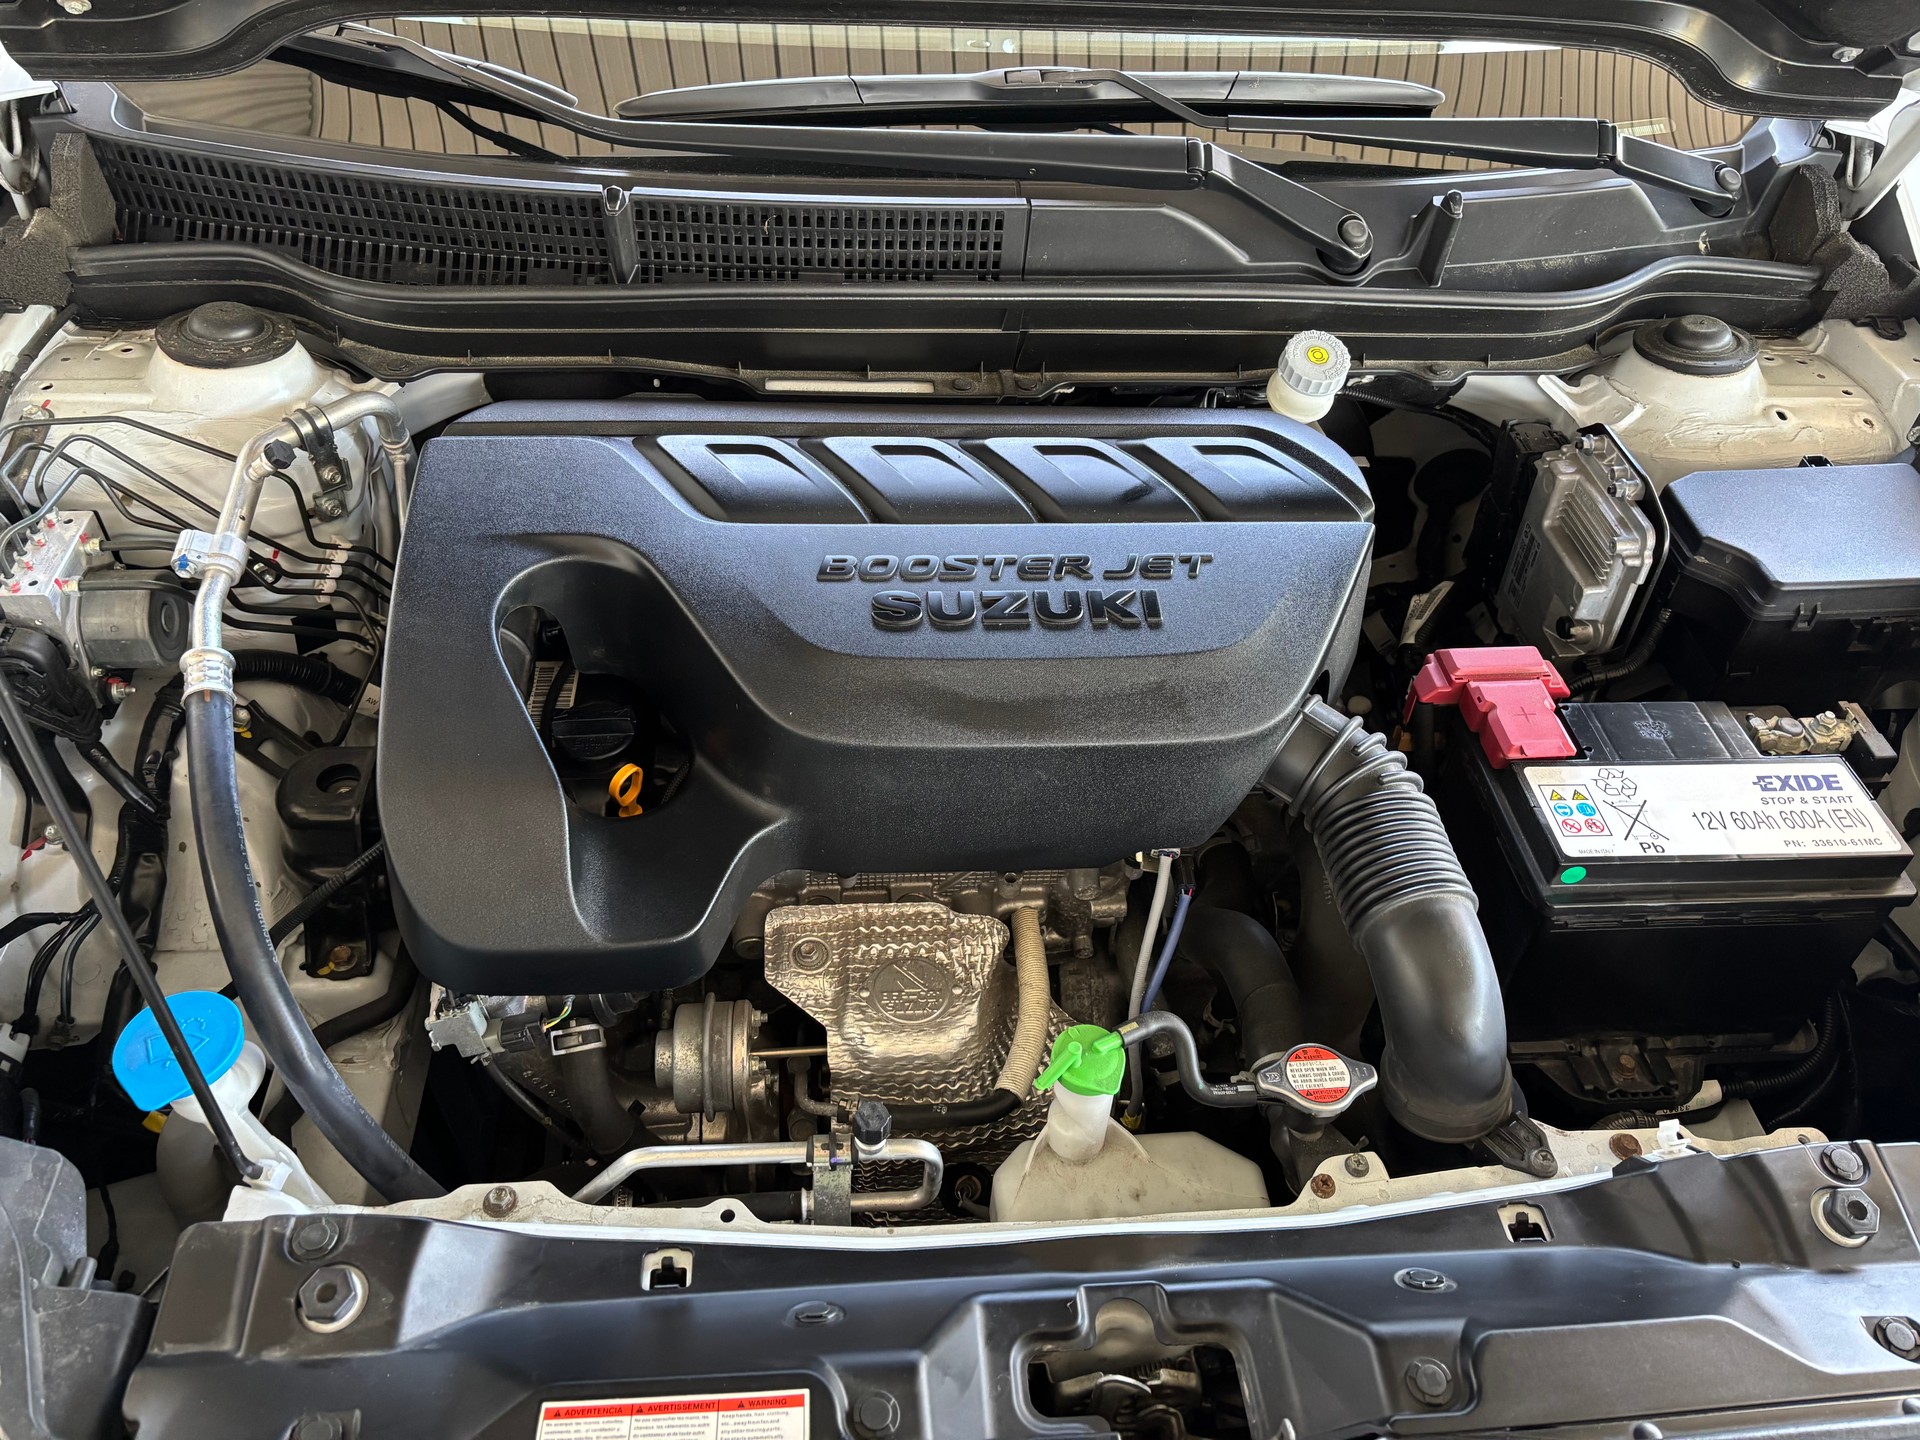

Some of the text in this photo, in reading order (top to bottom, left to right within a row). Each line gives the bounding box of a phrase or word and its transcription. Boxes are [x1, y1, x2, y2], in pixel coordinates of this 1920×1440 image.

[817, 552, 1214, 582] BOOSTER JET
[871, 588, 1164, 630] SUZUKI
[1752, 775, 1843, 792] EXIDE
[1760, 795, 1854, 805] STOP & START
[1692, 810, 1875, 832] 12V 60Ah 600A (EN)
[1639, 841, 1666, 854] Pb
[1784, 840, 1807, 848] PN:
[1812, 838, 1883, 848] 33610-61MC
[648, 1402, 716, 1412] AVERTISSEMENT
[749, 1398, 787, 1407] WARNING
[564, 1407, 623, 1417] ADVERTENCIA
